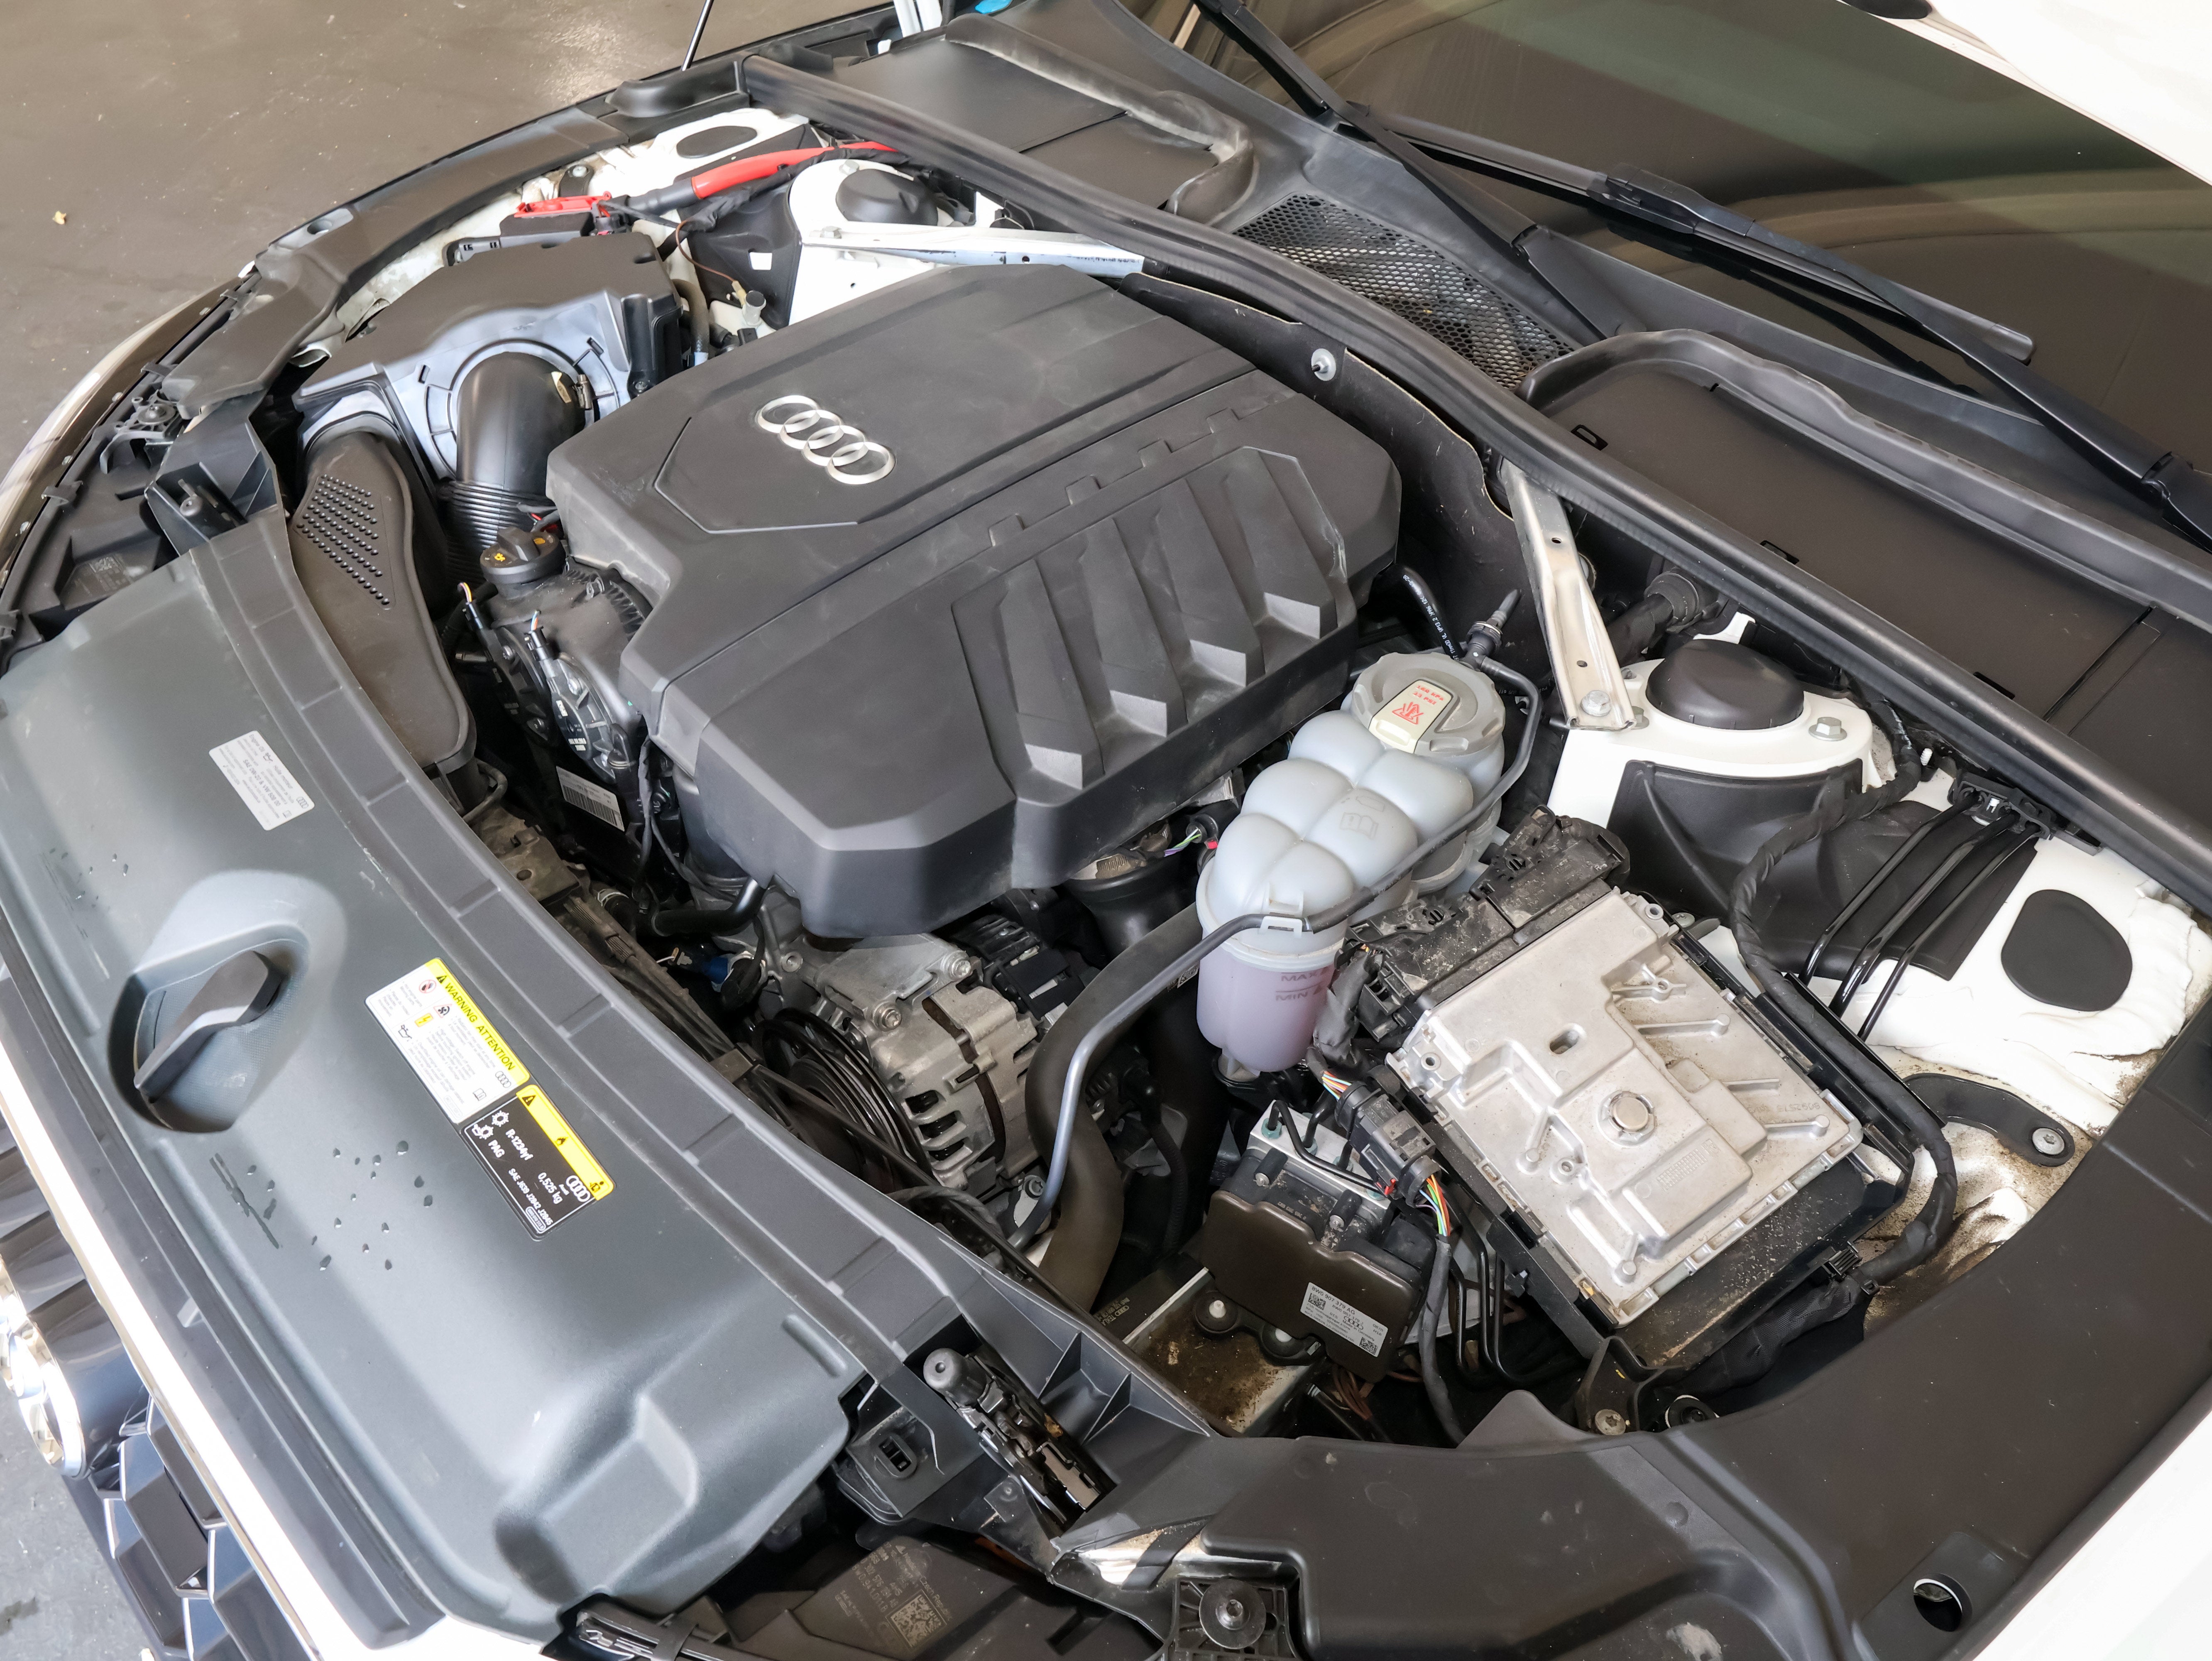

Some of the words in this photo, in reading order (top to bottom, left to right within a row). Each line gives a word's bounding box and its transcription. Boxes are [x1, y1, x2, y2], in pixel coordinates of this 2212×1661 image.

[1423, 696, 1436, 705] PSI
[1281, 972, 1317, 981] MAX
[1275, 992, 1308, 1000] MIN
[443, 983, 478, 1022] WARNING
[475, 1024, 515, 1070] ATTENTION
[487, 1139, 506, 1158] PAG
[507, 1167, 521, 1181] SAE
[503, 1128, 534, 1163] R-1234yf
[536, 1171, 557, 1195] 0,525
[549, 1191, 565, 1205] kg
[1324, 1294, 1335, 1302] 907
[1335, 1300, 1346, 1309] 379
